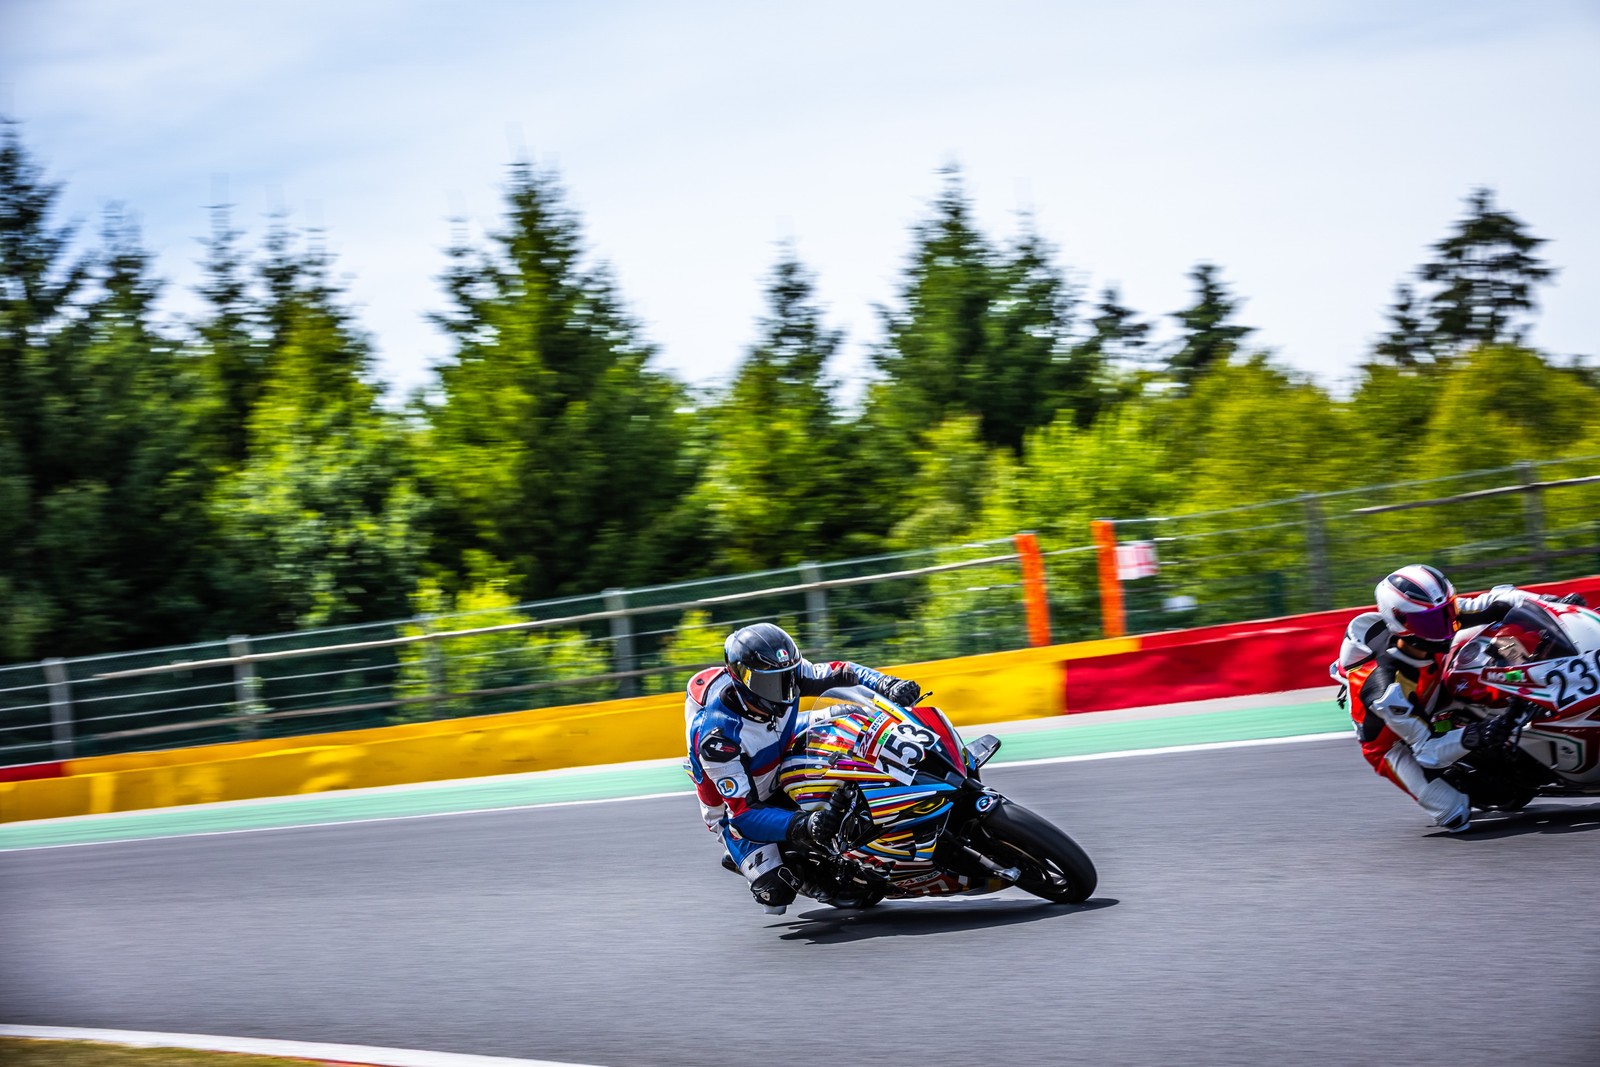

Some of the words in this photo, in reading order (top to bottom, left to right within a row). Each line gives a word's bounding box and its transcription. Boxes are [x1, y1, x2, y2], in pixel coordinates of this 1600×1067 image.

[1487, 672, 1527, 682] MOL
[860, 731, 873, 757] 24
[878, 724, 935, 777] 153
